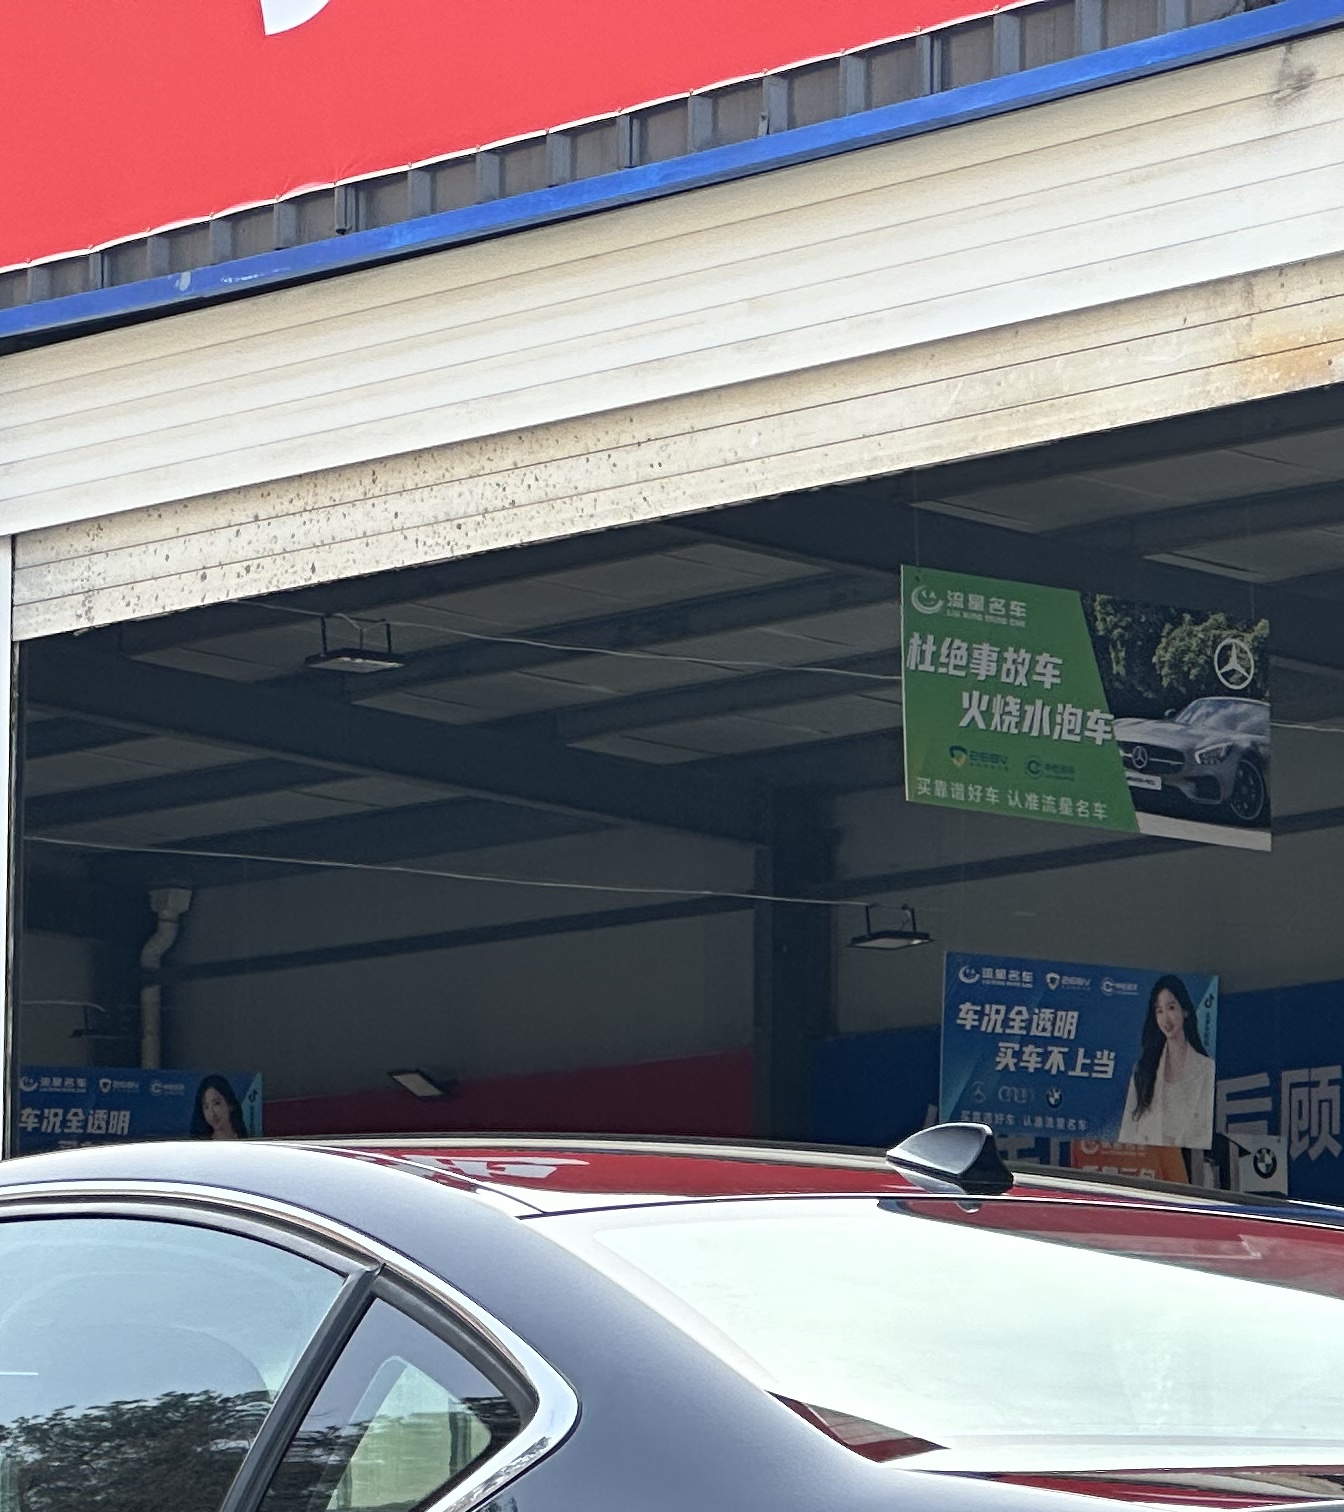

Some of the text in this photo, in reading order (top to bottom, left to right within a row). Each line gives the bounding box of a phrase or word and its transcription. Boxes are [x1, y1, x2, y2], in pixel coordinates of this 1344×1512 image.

[947, 590, 1026, 617] 流星名车
[906, 632, 1063, 689] 杜绝事故车
[959, 690, 1115, 745] 火烧水泡车
[916, 777, 1109, 820] 买靠谱好车 认准流星名车
[956, 1002, 1079, 1040] 车况全透明
[995, 1042, 1116, 1079] 买车不上当
[19, 1107, 131, 1135] 车况全透明
